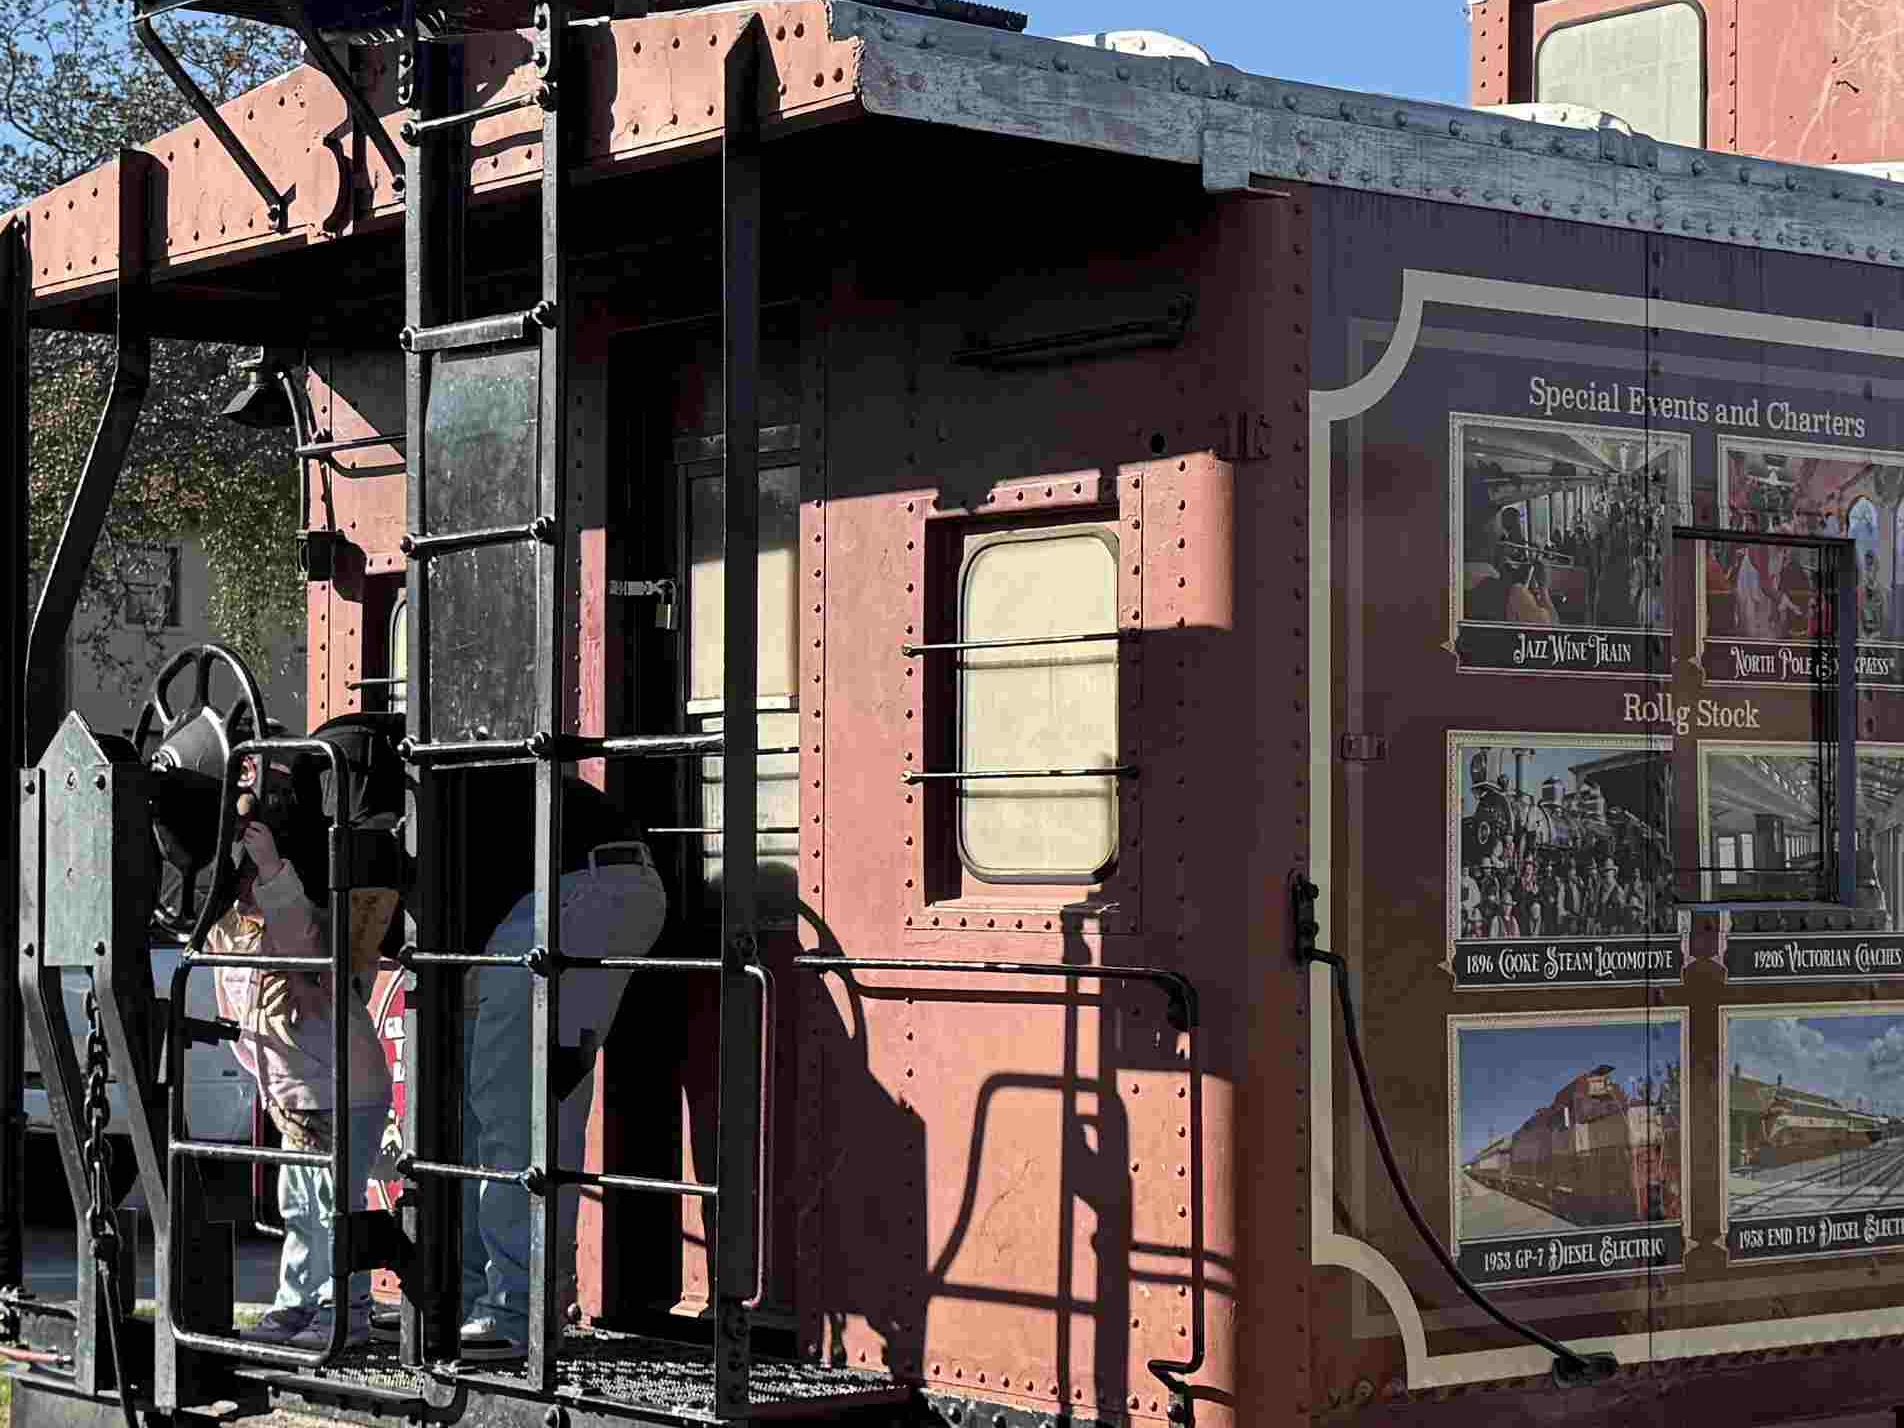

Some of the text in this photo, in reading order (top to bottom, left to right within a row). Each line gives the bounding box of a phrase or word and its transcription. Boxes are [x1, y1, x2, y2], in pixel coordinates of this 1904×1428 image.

[1529, 376, 1865, 438] Special Events and Charters
[1697, 700, 1760, 728] Stock
[1467, 955, 1493, 973] 1896
